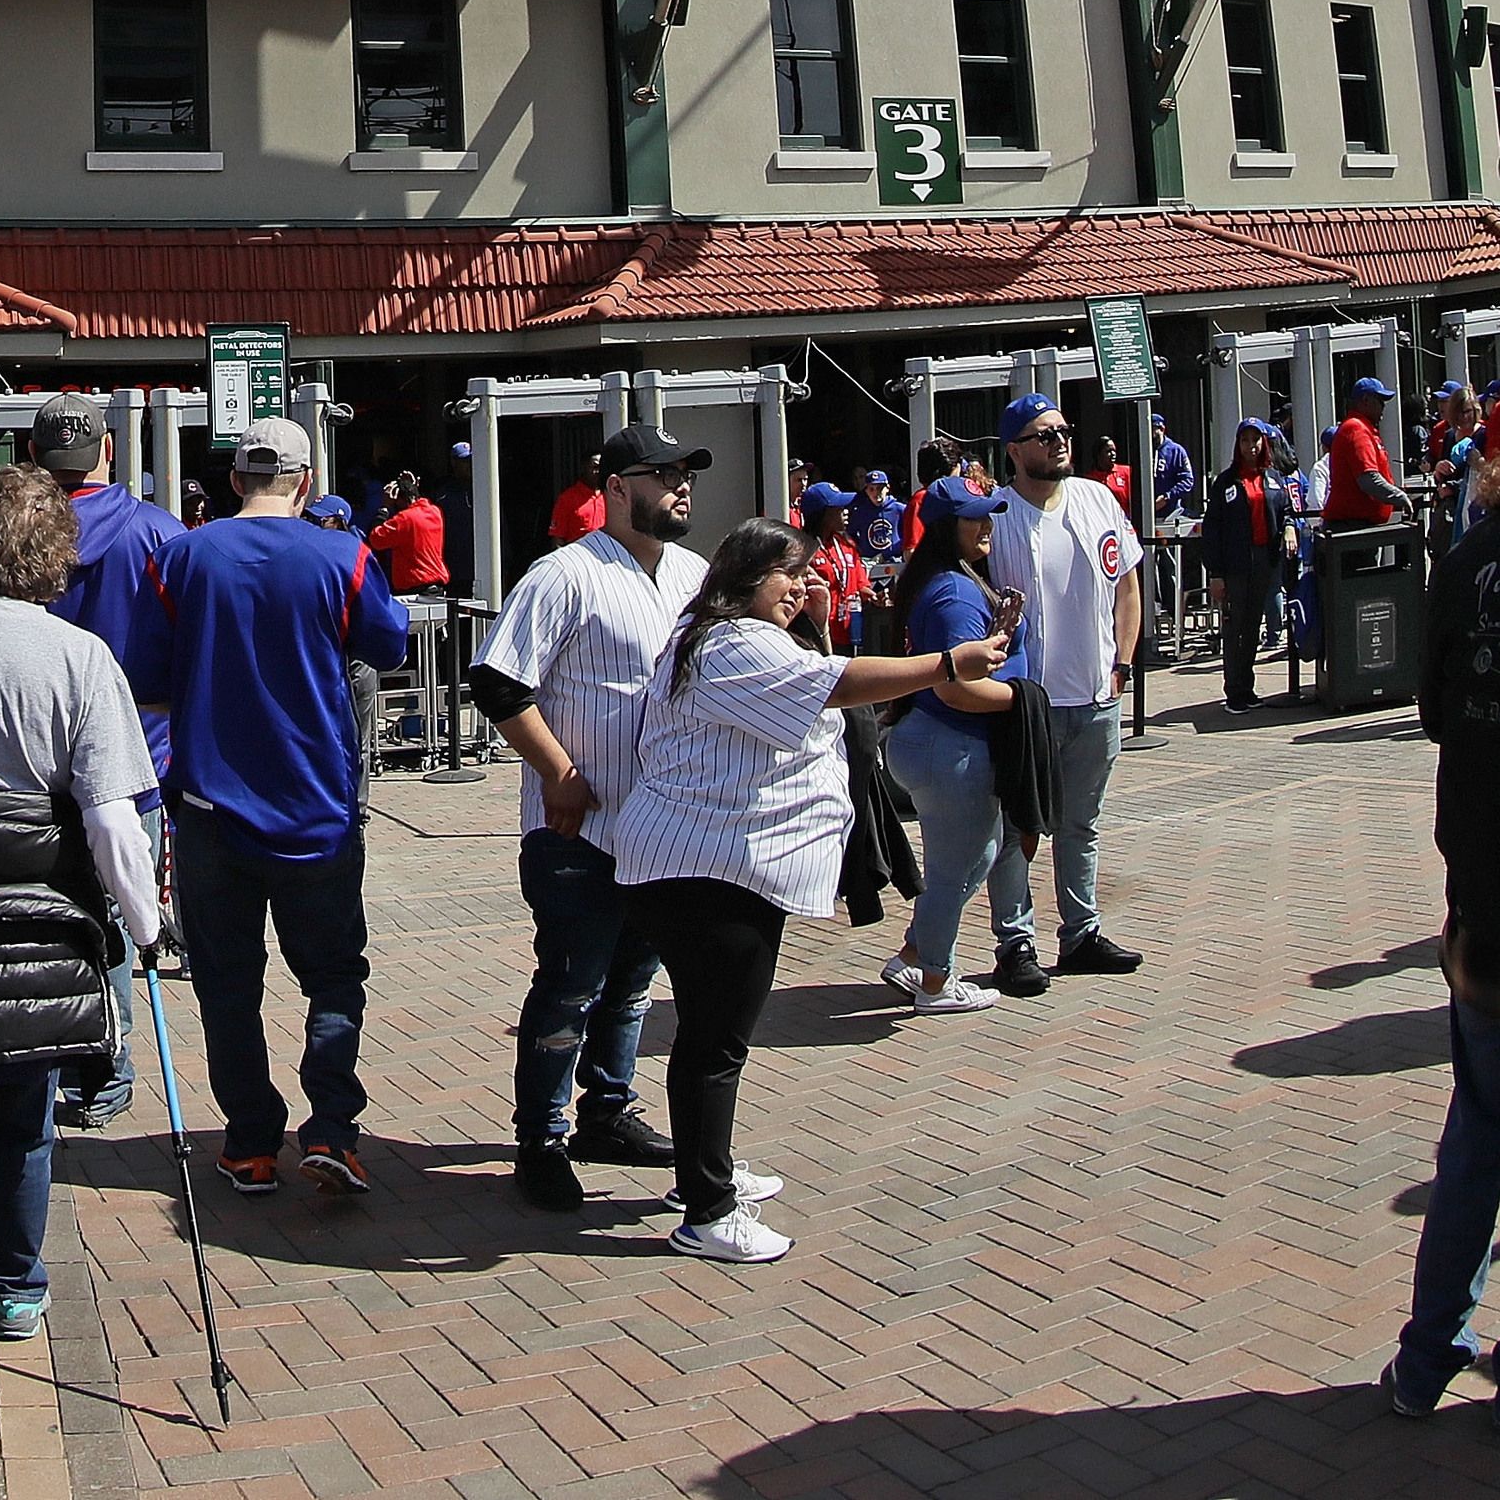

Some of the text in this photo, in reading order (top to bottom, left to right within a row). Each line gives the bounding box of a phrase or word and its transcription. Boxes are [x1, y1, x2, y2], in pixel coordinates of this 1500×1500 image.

[879, 103, 952, 122] GATE
[893, 123, 946, 182] 3
[213, 341, 282, 350] METAL DETECTORS
[236, 349, 260, 357] IN USE
